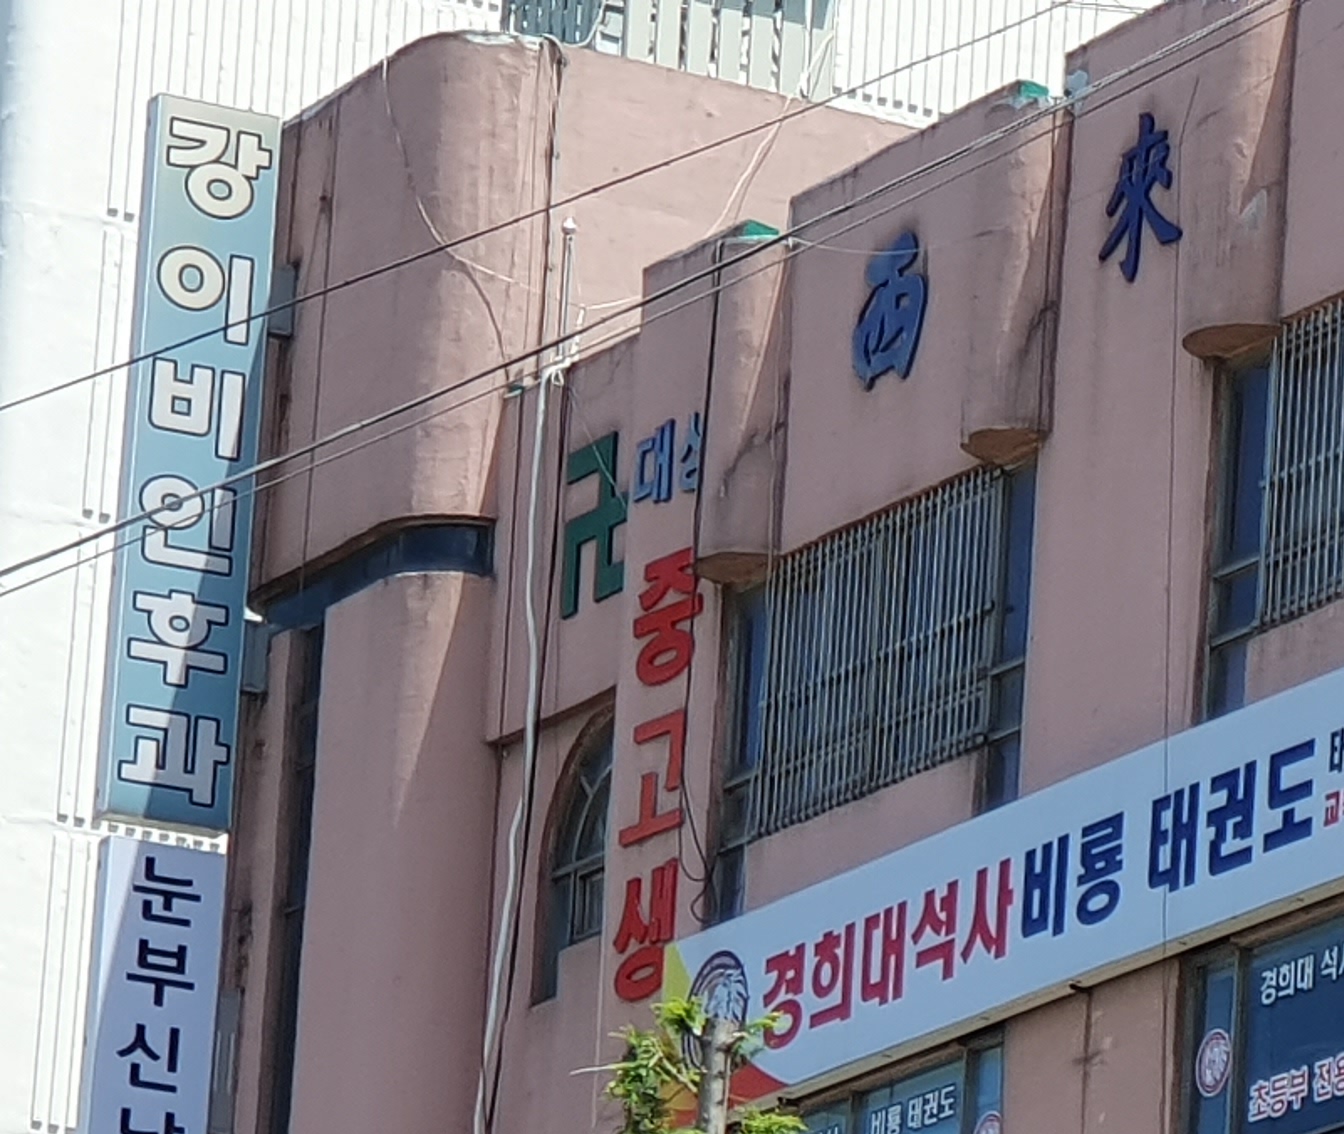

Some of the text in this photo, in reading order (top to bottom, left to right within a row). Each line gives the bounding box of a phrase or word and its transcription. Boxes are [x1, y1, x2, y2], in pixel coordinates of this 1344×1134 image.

[117, 115, 275, 810] 강이비인후과
[611, 546, 704, 1002] 중고생
[1147, 736, 1317, 894] 태권도
[1259, 957, 1314, 1006] 경희대
